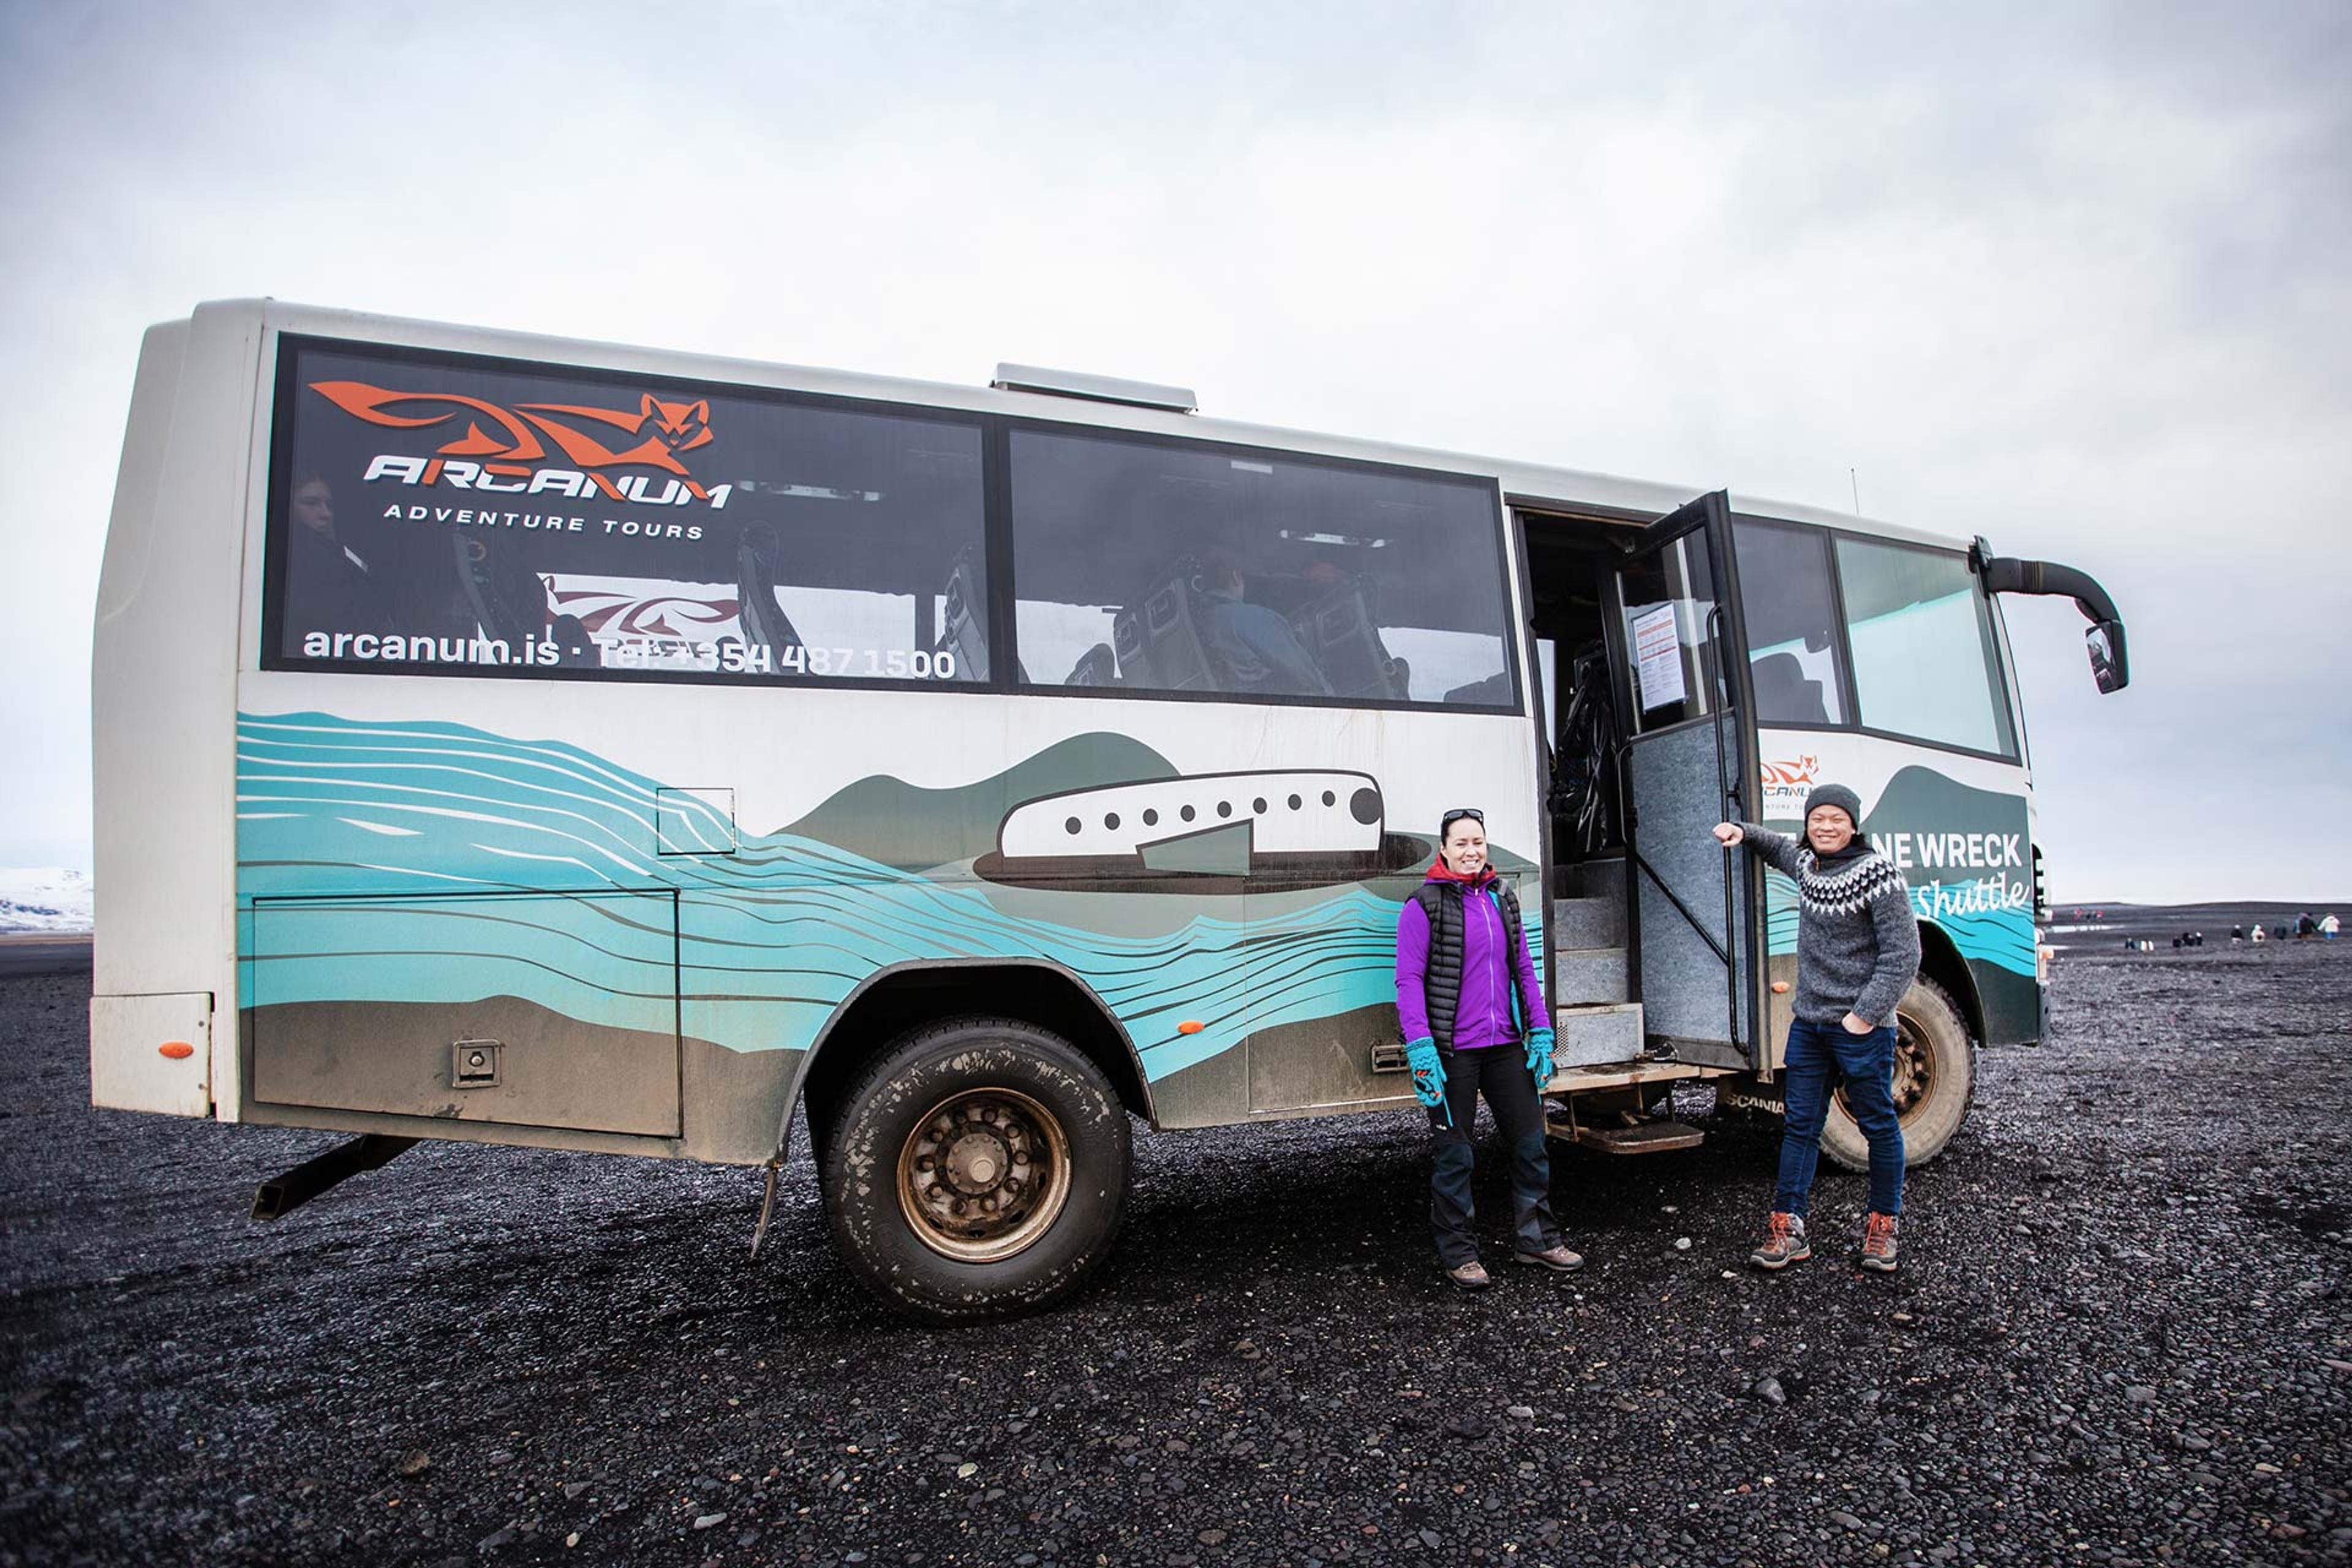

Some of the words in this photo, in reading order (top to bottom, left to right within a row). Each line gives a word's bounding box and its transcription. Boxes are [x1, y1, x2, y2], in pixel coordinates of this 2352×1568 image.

[363, 455, 733, 509] ARCANUM
[383, 504, 585, 531] ADVENTURE
[603, 519, 704, 540] TOURS
[303, 631, 560, 665] arcanum.is
[782, 645, 854, 675] 487
[864, 649, 956, 679] 1500
[1917, 833, 2022, 867] WRECK
[1916, 871, 2029, 918] Shuttle
[1726, 1094, 1785, 1115] SCANIA
